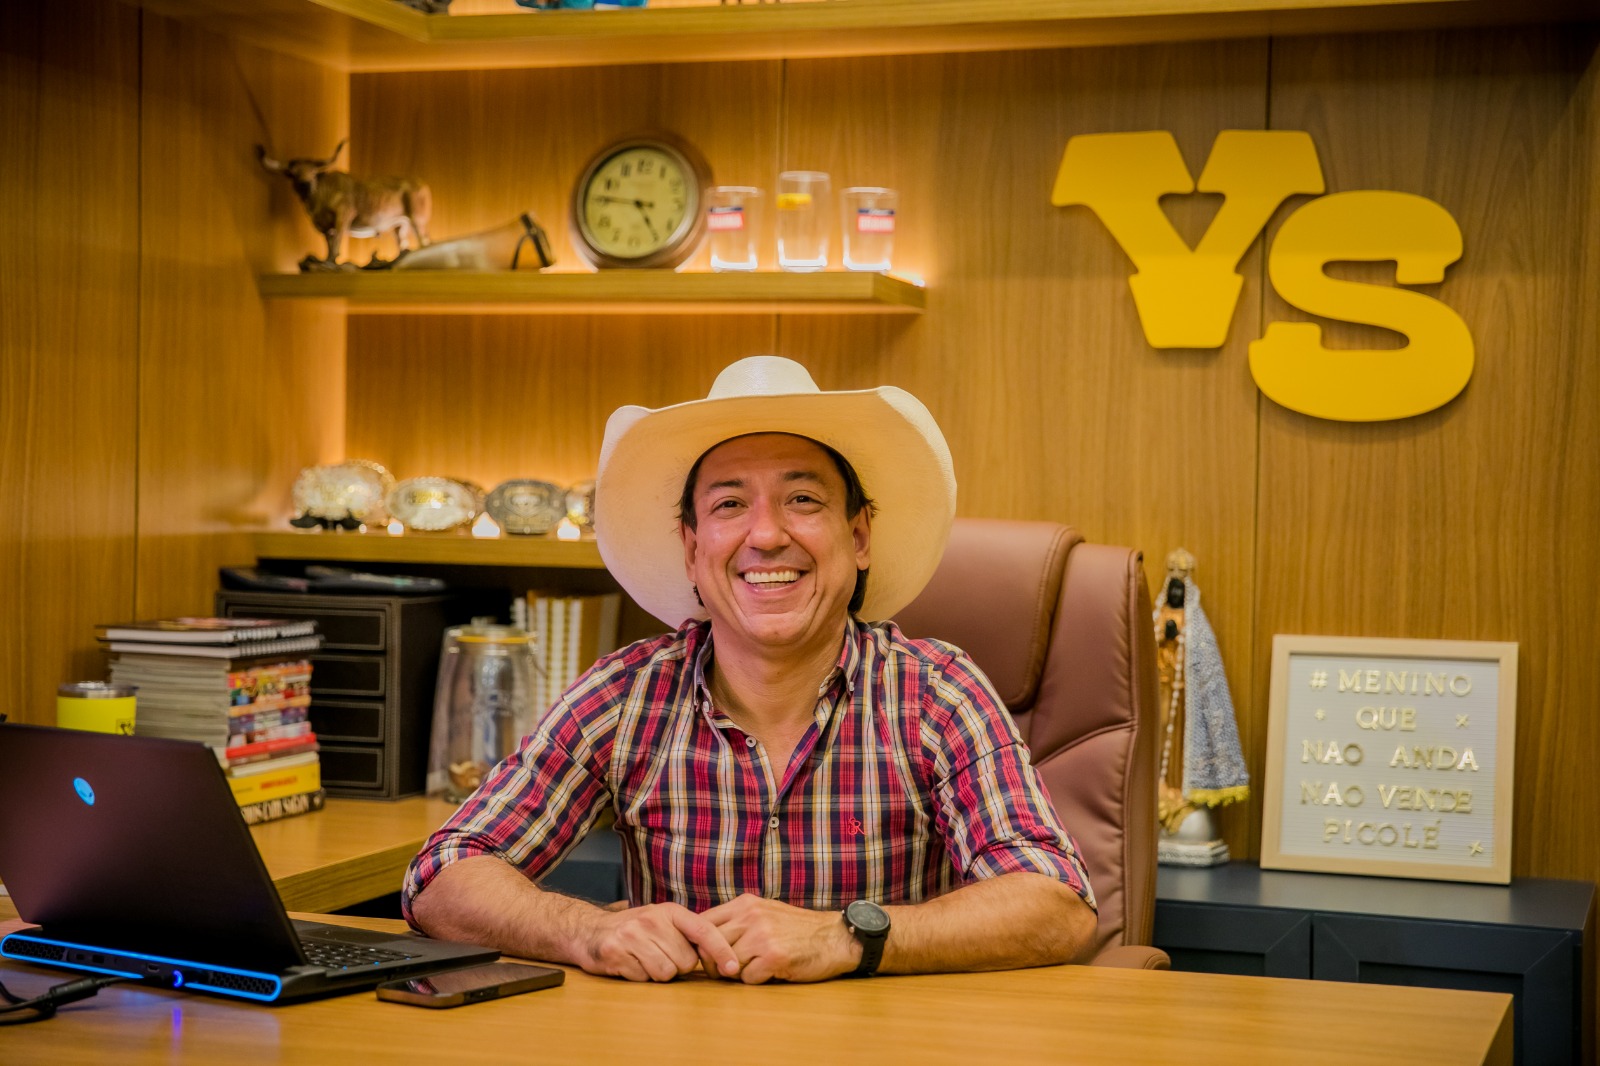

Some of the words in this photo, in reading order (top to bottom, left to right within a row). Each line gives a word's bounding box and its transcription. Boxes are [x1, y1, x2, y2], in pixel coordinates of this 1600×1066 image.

[1338, 669, 1473, 697] MENINO
[1355, 706, 1417, 732] QUE
[1301, 739, 1363, 766] NAO
[1389, 745, 1480, 772] ANDA
[1300, 781, 1364, 808] NAO
[1377, 784, 1473, 814] VENDE
[1322, 818, 1442, 849] PICOLÉ
